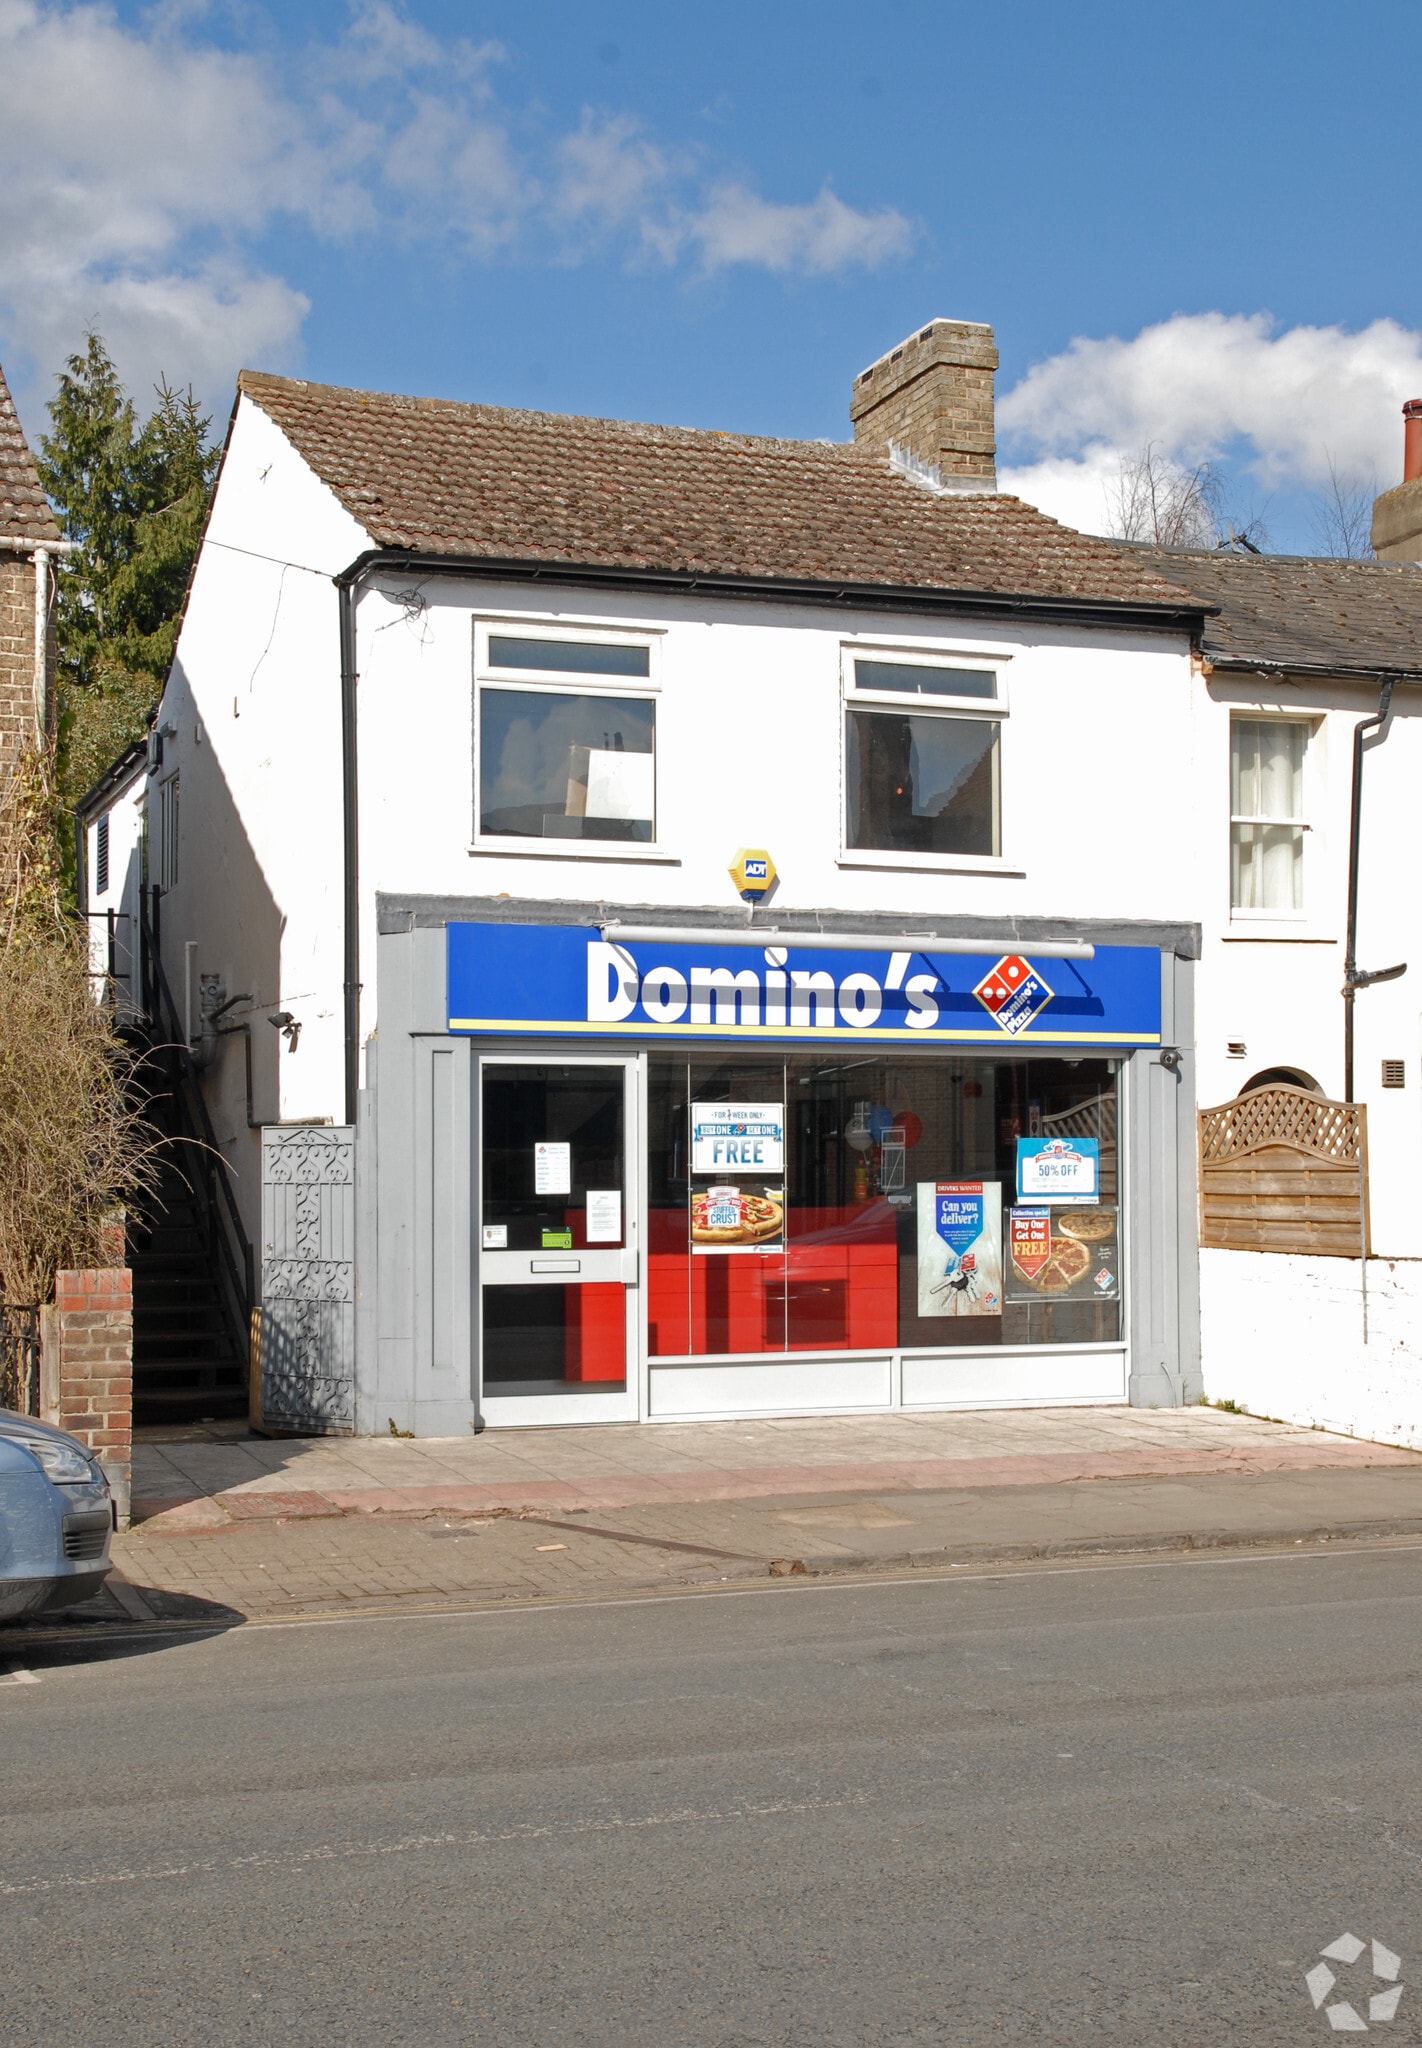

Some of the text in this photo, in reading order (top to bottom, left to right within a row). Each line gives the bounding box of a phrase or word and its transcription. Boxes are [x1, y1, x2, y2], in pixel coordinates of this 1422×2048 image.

[745, 863, 767, 875] ADT
[587, 941, 940, 1029] Domino's
[997, 980, 1038, 1025] Domino's
[1005, 1006, 1033, 1033] Pizza
[714, 1111, 727, 1119] FOR
[732, 1111, 748, 1119] WEEK
[748, 1111, 763, 1119] ONLY
[702, 1125, 776, 1135] BUY ONE GET ONE
[713, 1139, 764, 1164] FREE
[1038, 1164, 1079, 1177] 50% OFF
[713, 1205, 736, 1213] STUFFED
[941, 1200, 978, 1214] Can you
[710, 1213, 738, 1224] CRUST
[941, 1212, 979, 1225] deliver?
[1015, 1220, 1045, 1231] Buy One
[1016, 1231, 1045, 1240] Get One
[1013, 1241, 1048, 1256] FREE
